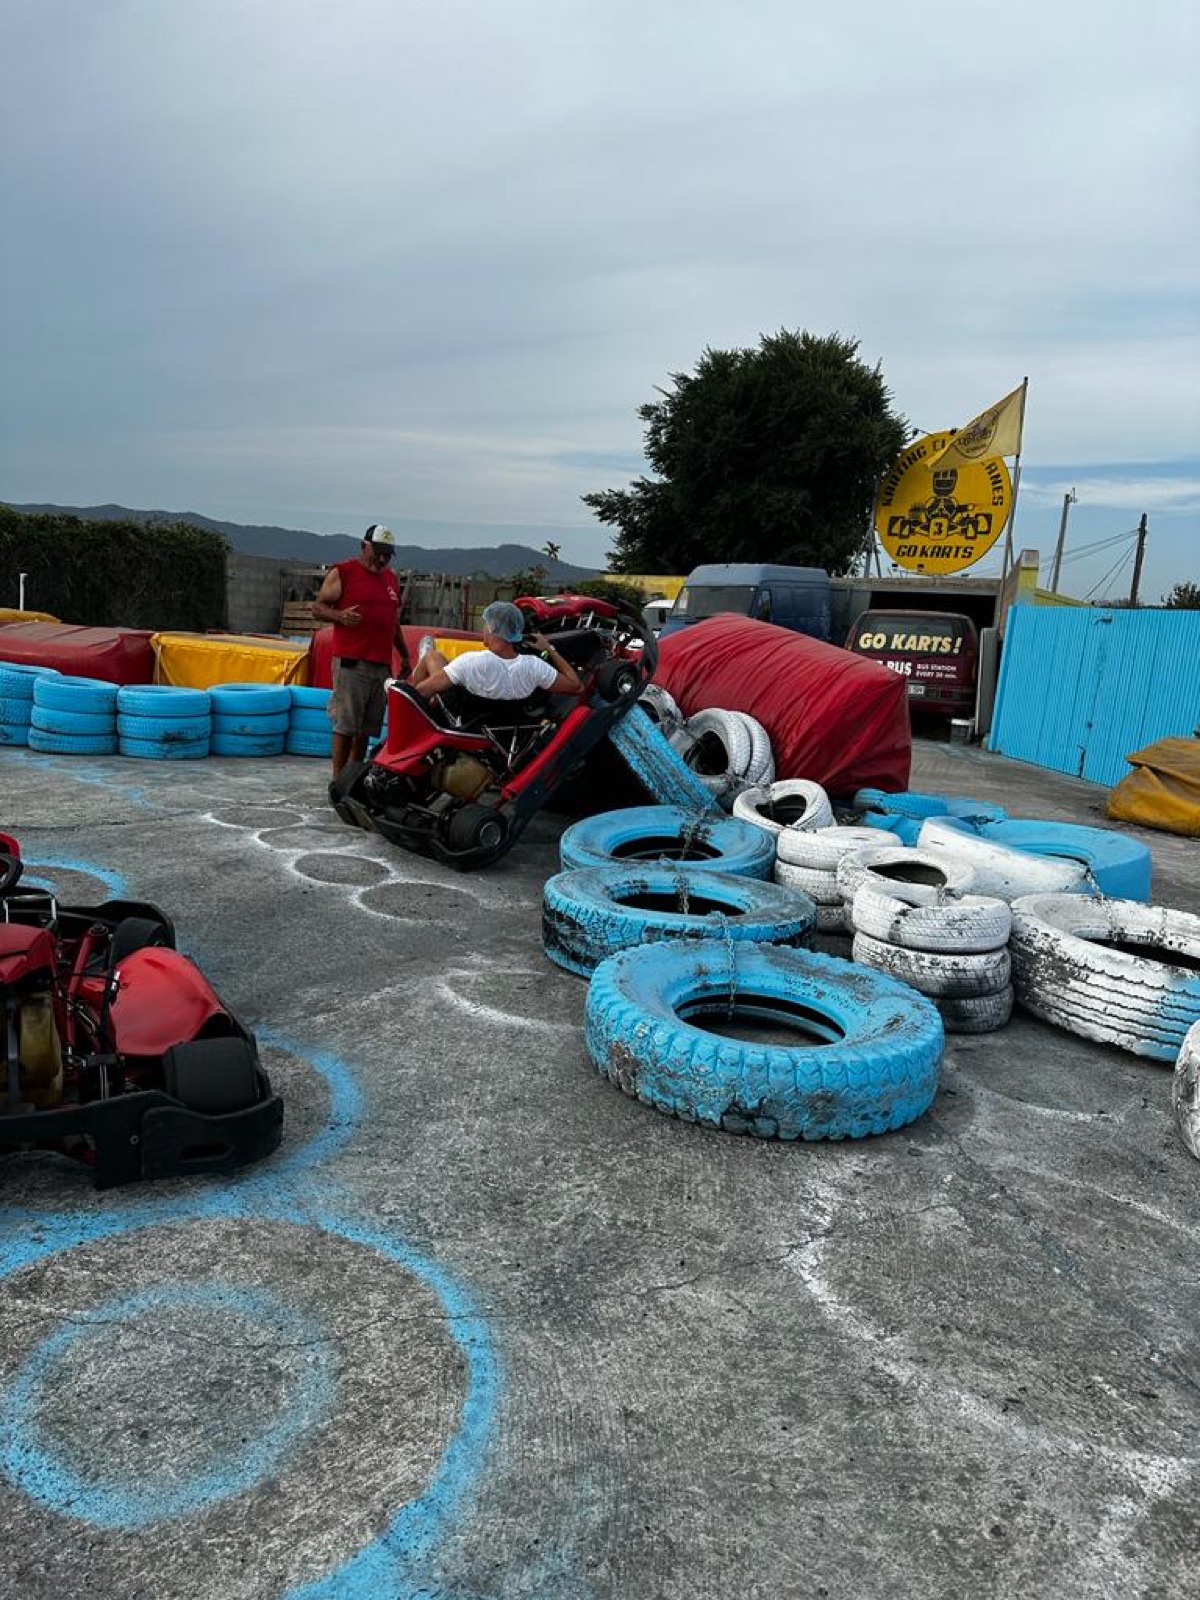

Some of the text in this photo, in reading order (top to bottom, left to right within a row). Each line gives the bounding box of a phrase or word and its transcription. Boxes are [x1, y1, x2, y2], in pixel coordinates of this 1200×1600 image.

[882, 444, 928, 507] KARTING
[933, 521, 944, 535] 3
[896, 544, 974, 558] GO KARTS
[859, 632, 963, 654] GO KARTS!
